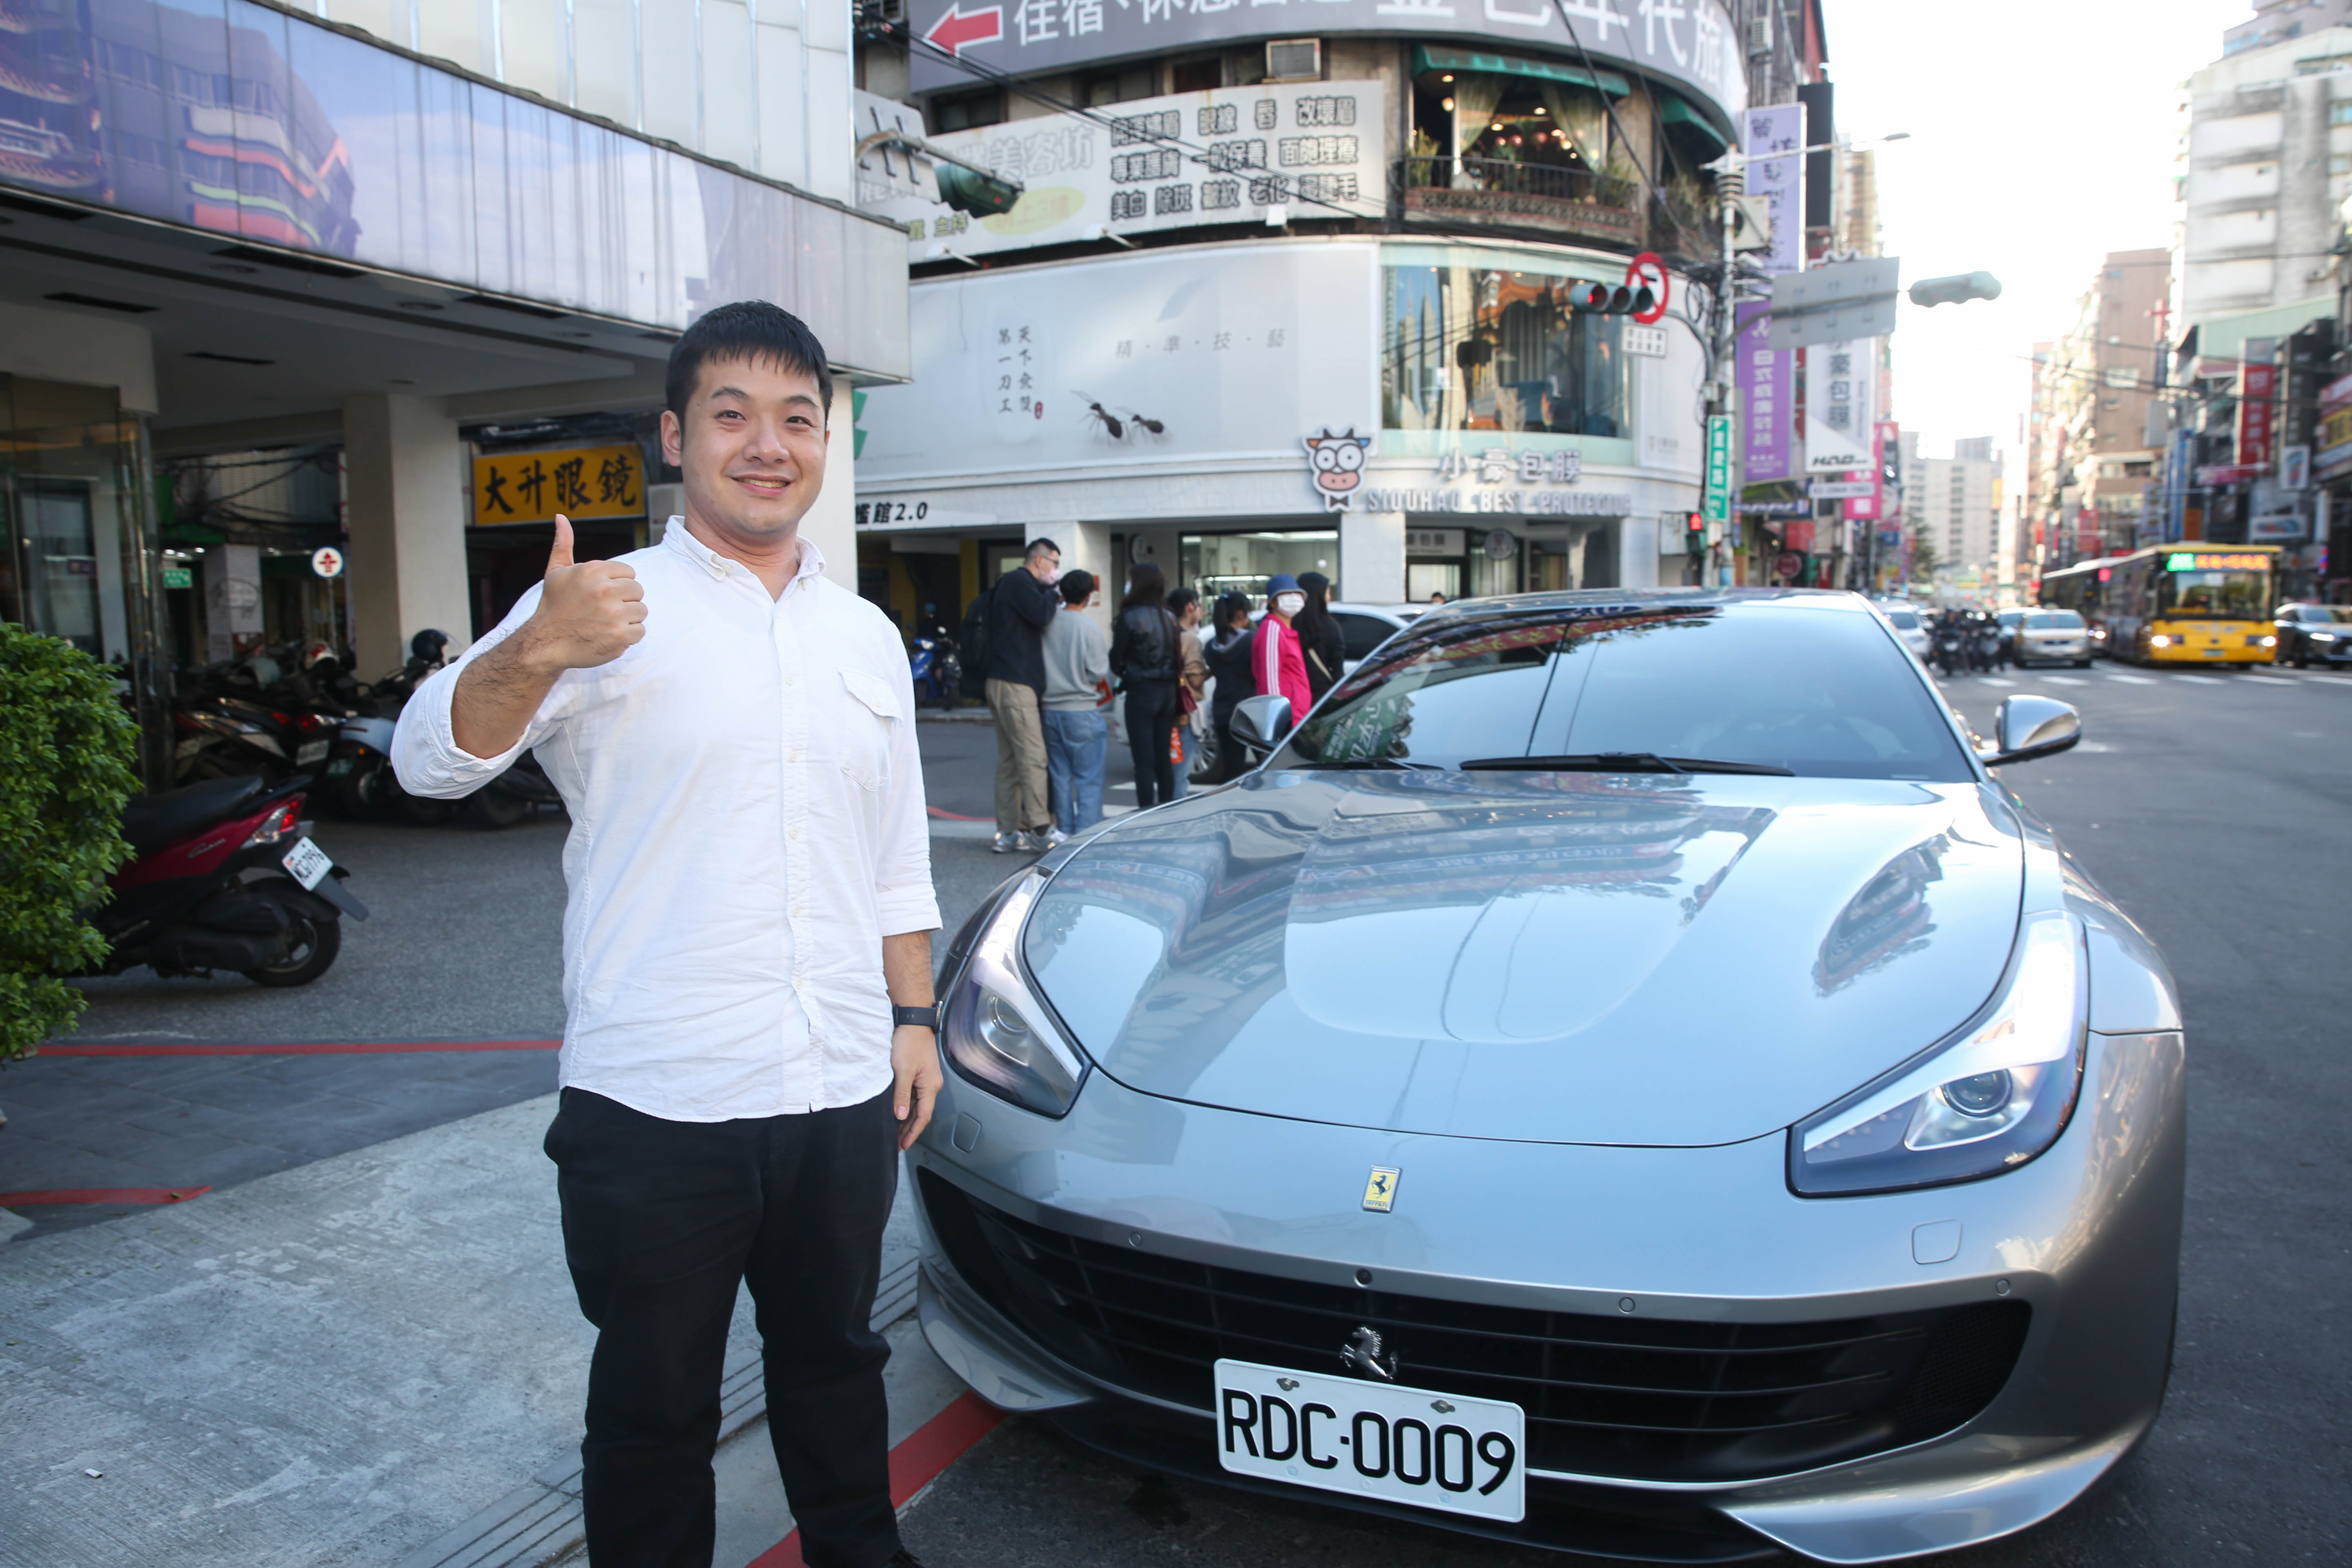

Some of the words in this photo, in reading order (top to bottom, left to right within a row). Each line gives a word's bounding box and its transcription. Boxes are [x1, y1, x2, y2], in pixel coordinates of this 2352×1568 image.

[1111, 189, 1147, 220] 美白
[1439, 449, 1581, 483] 小豪包膜
[484, 453, 637, 515] 大升眼鏡
